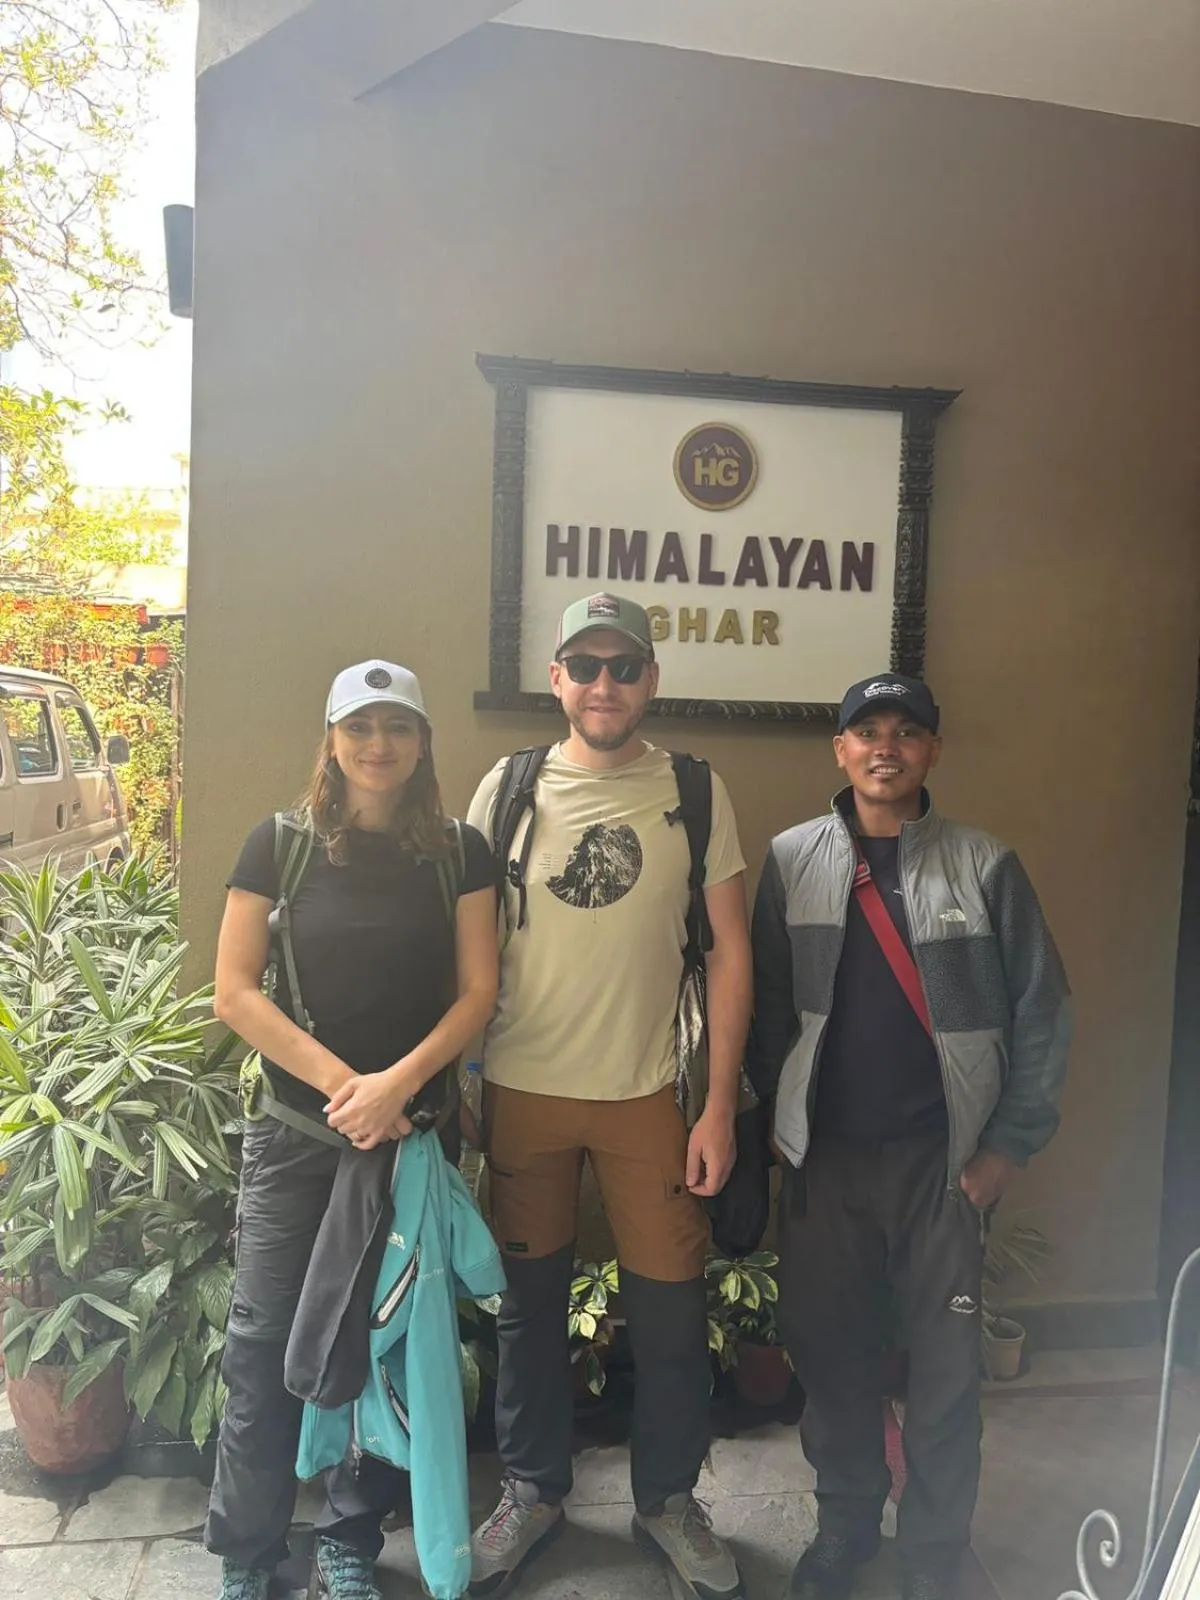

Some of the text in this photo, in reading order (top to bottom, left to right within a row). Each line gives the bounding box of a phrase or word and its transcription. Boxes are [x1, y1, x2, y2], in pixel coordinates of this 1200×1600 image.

[694, 457, 739, 487] HG
[546, 524, 875, 592] HIMALAYAN
[646, 605, 780, 645] GHAR
